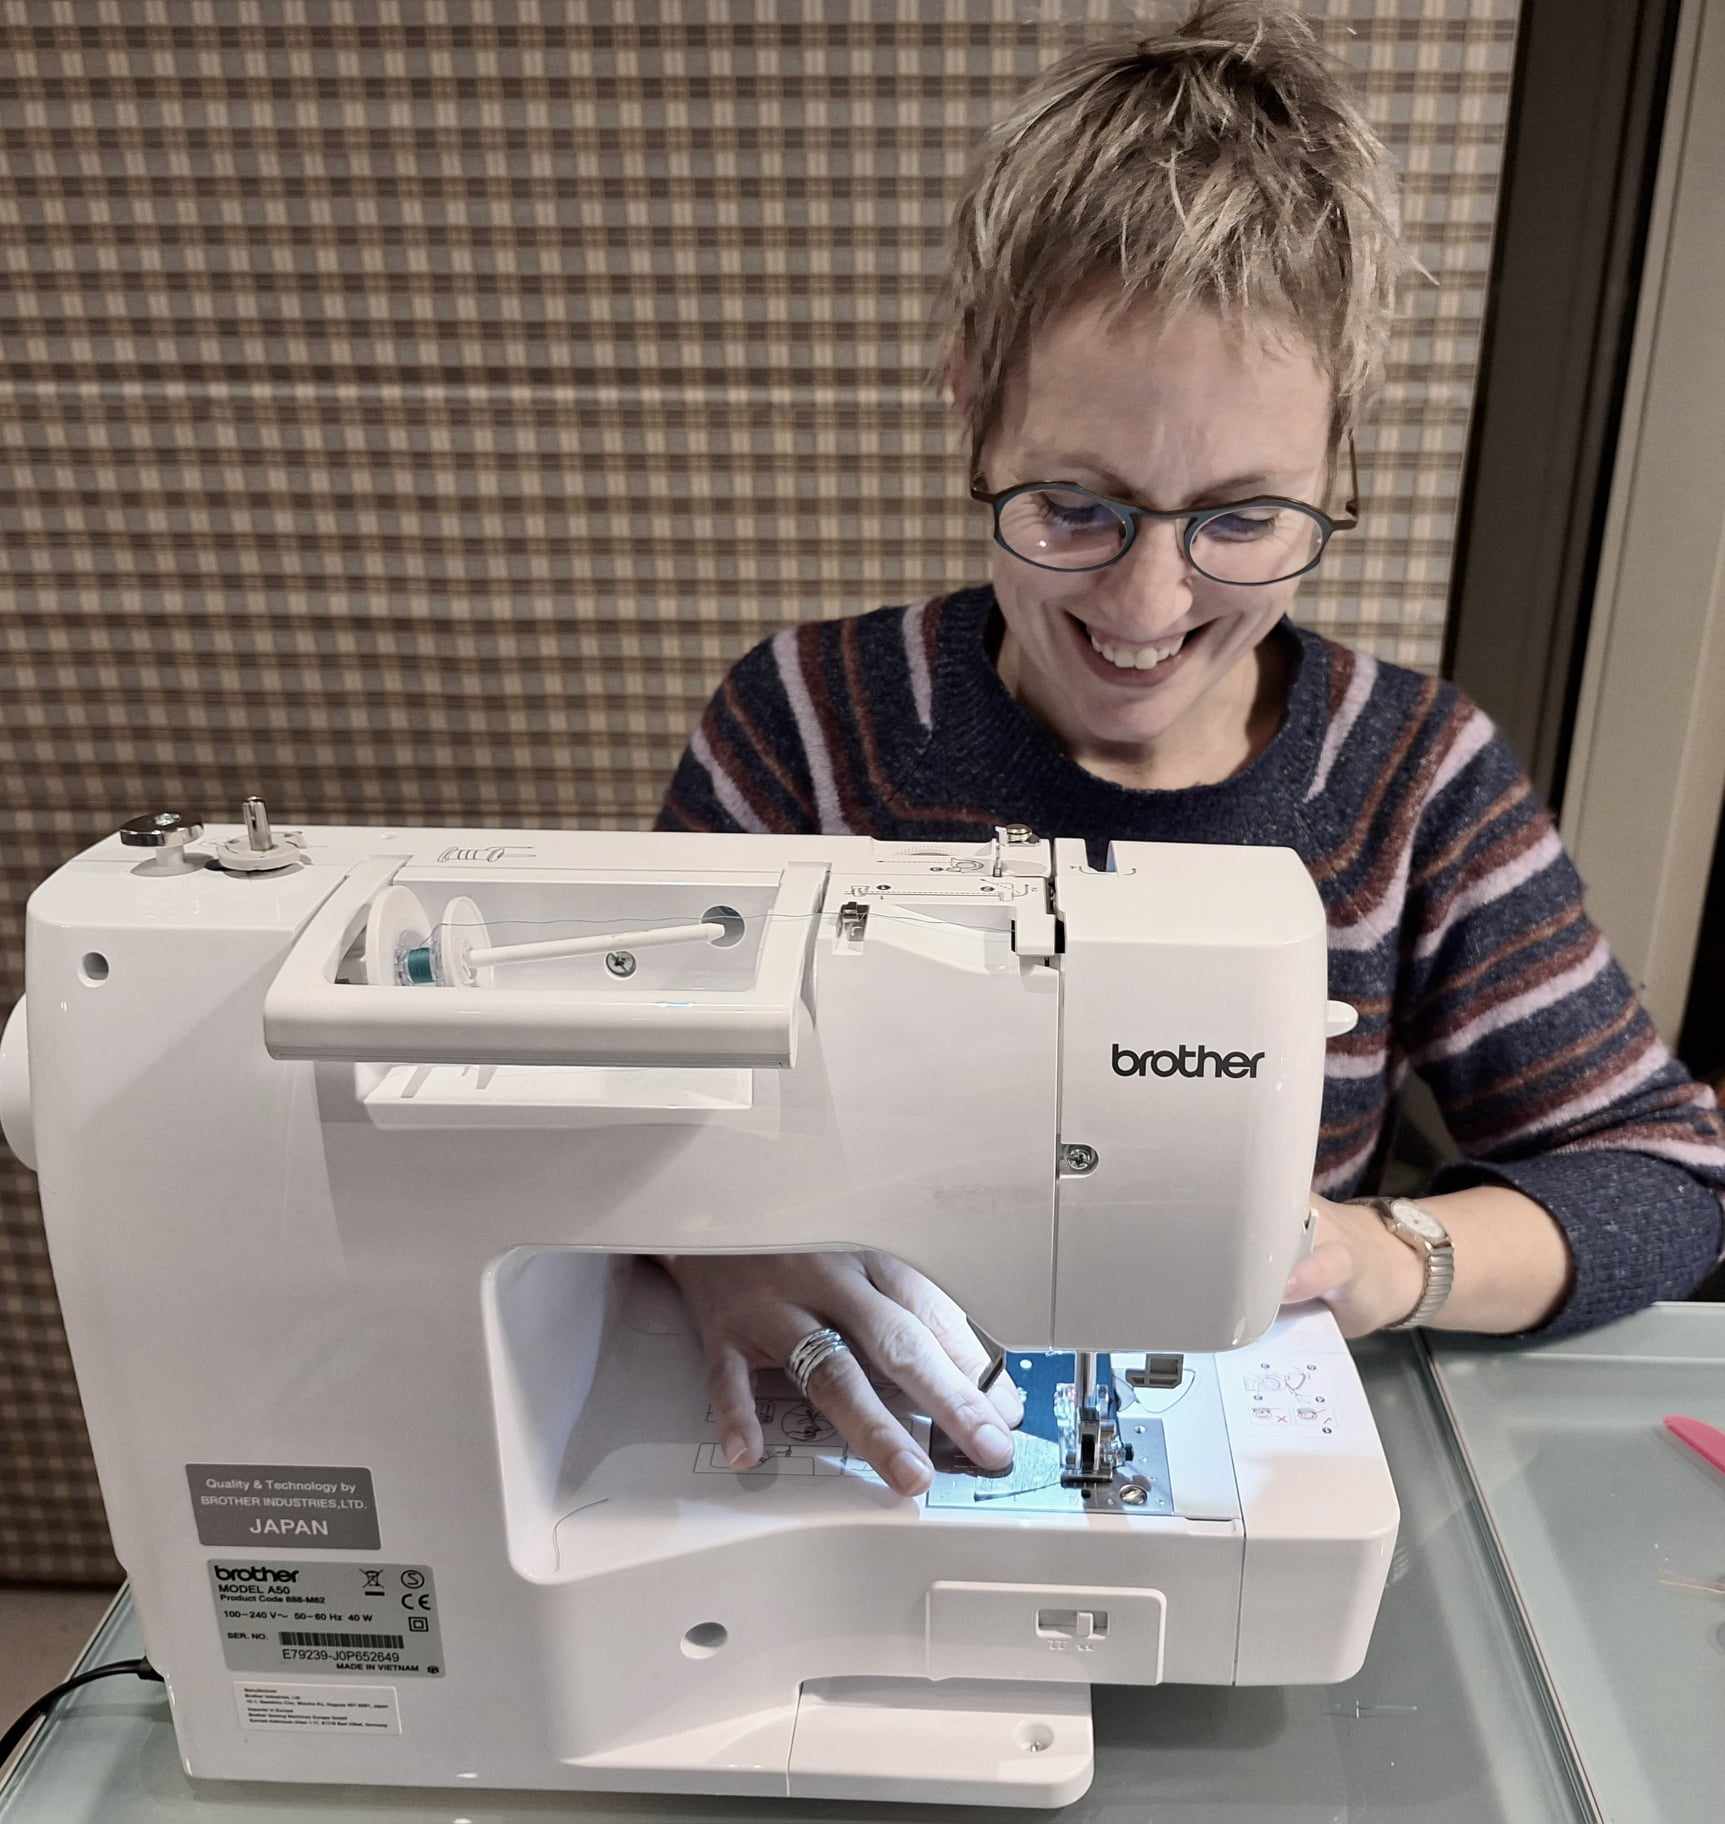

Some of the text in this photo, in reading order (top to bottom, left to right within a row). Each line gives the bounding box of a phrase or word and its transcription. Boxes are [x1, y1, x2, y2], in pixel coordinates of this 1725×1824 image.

[1111, 1043, 1265, 1079] brother
[206, 1478, 357, 1494] Quality & Technology by
[200, 1495, 261, 1507] BROTHER
[249, 1518, 329, 1536] JAPAN
[214, 1564, 300, 1583] brother
[218, 1583, 291, 1595] MODEL A50
[220, 1594, 257, 1602] Product
[259, 1595, 284, 1603] Code
[329, 1613, 342, 1622] Hz
[347, 1614, 361, 1622] 40
[362, 1614, 373, 1622] W
[336, 1663, 419, 1672] MADE IN VIETNAM
